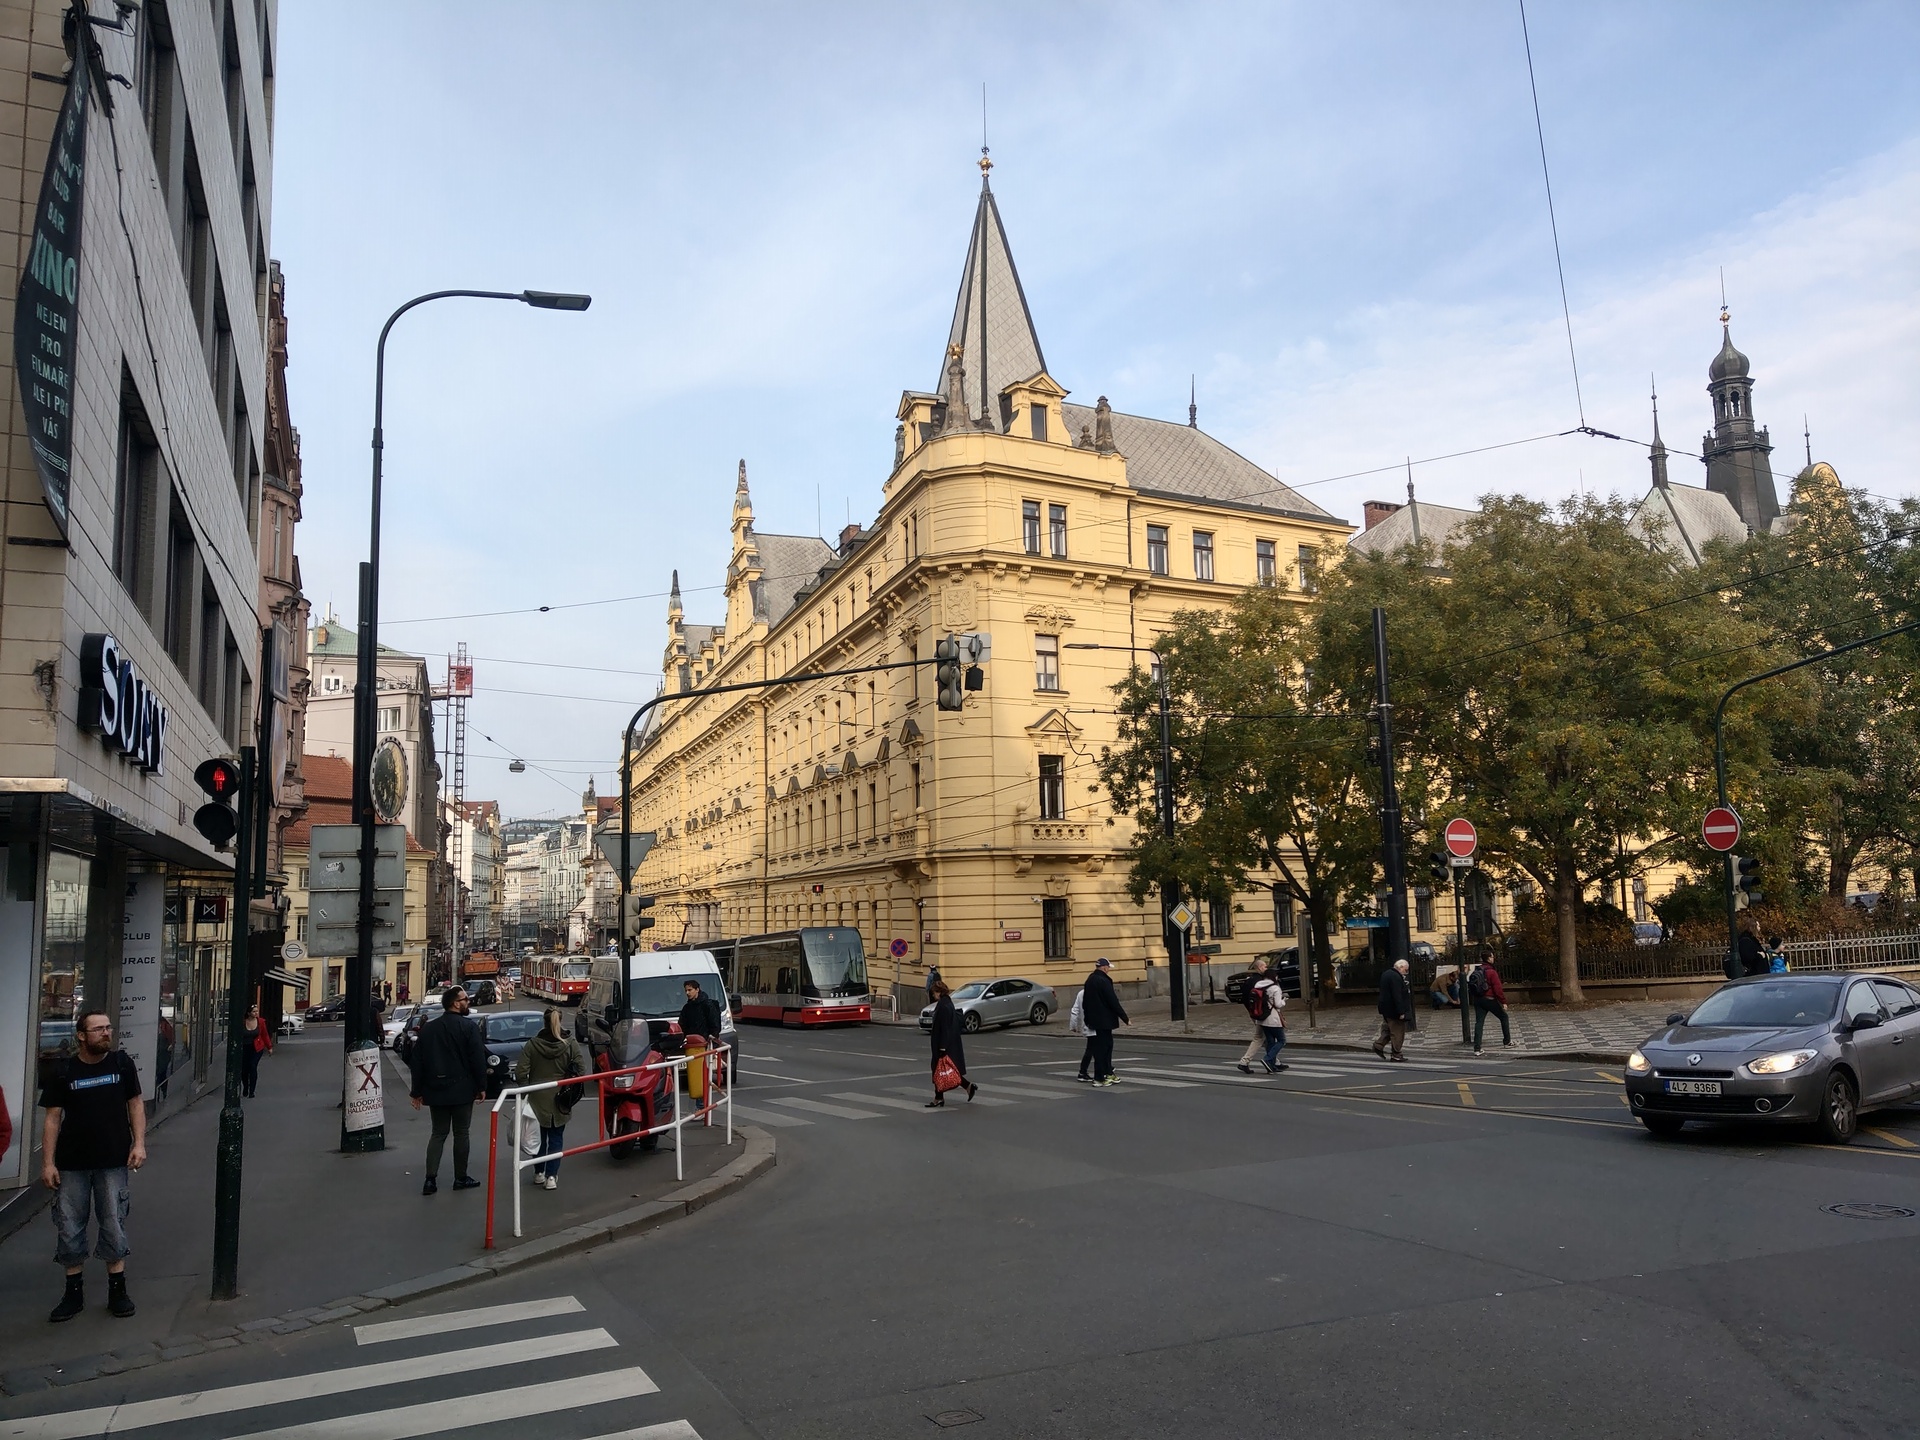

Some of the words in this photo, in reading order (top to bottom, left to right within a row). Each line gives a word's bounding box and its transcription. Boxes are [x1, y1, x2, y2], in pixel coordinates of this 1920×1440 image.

[48, 201, 65, 234] BAR
[31, 228, 76, 305] KINO
[36, 302, 67, 334] NEJEN
[40, 333, 61, 358] PRO
[42, 416, 58, 439] VÁS
[101, 633, 169, 777] SONY
[1672, 1082, 1688, 1092] 4L2
[1694, 1083, 1717, 1093] 9366
[349, 1098, 376, 1109] BLOODY
